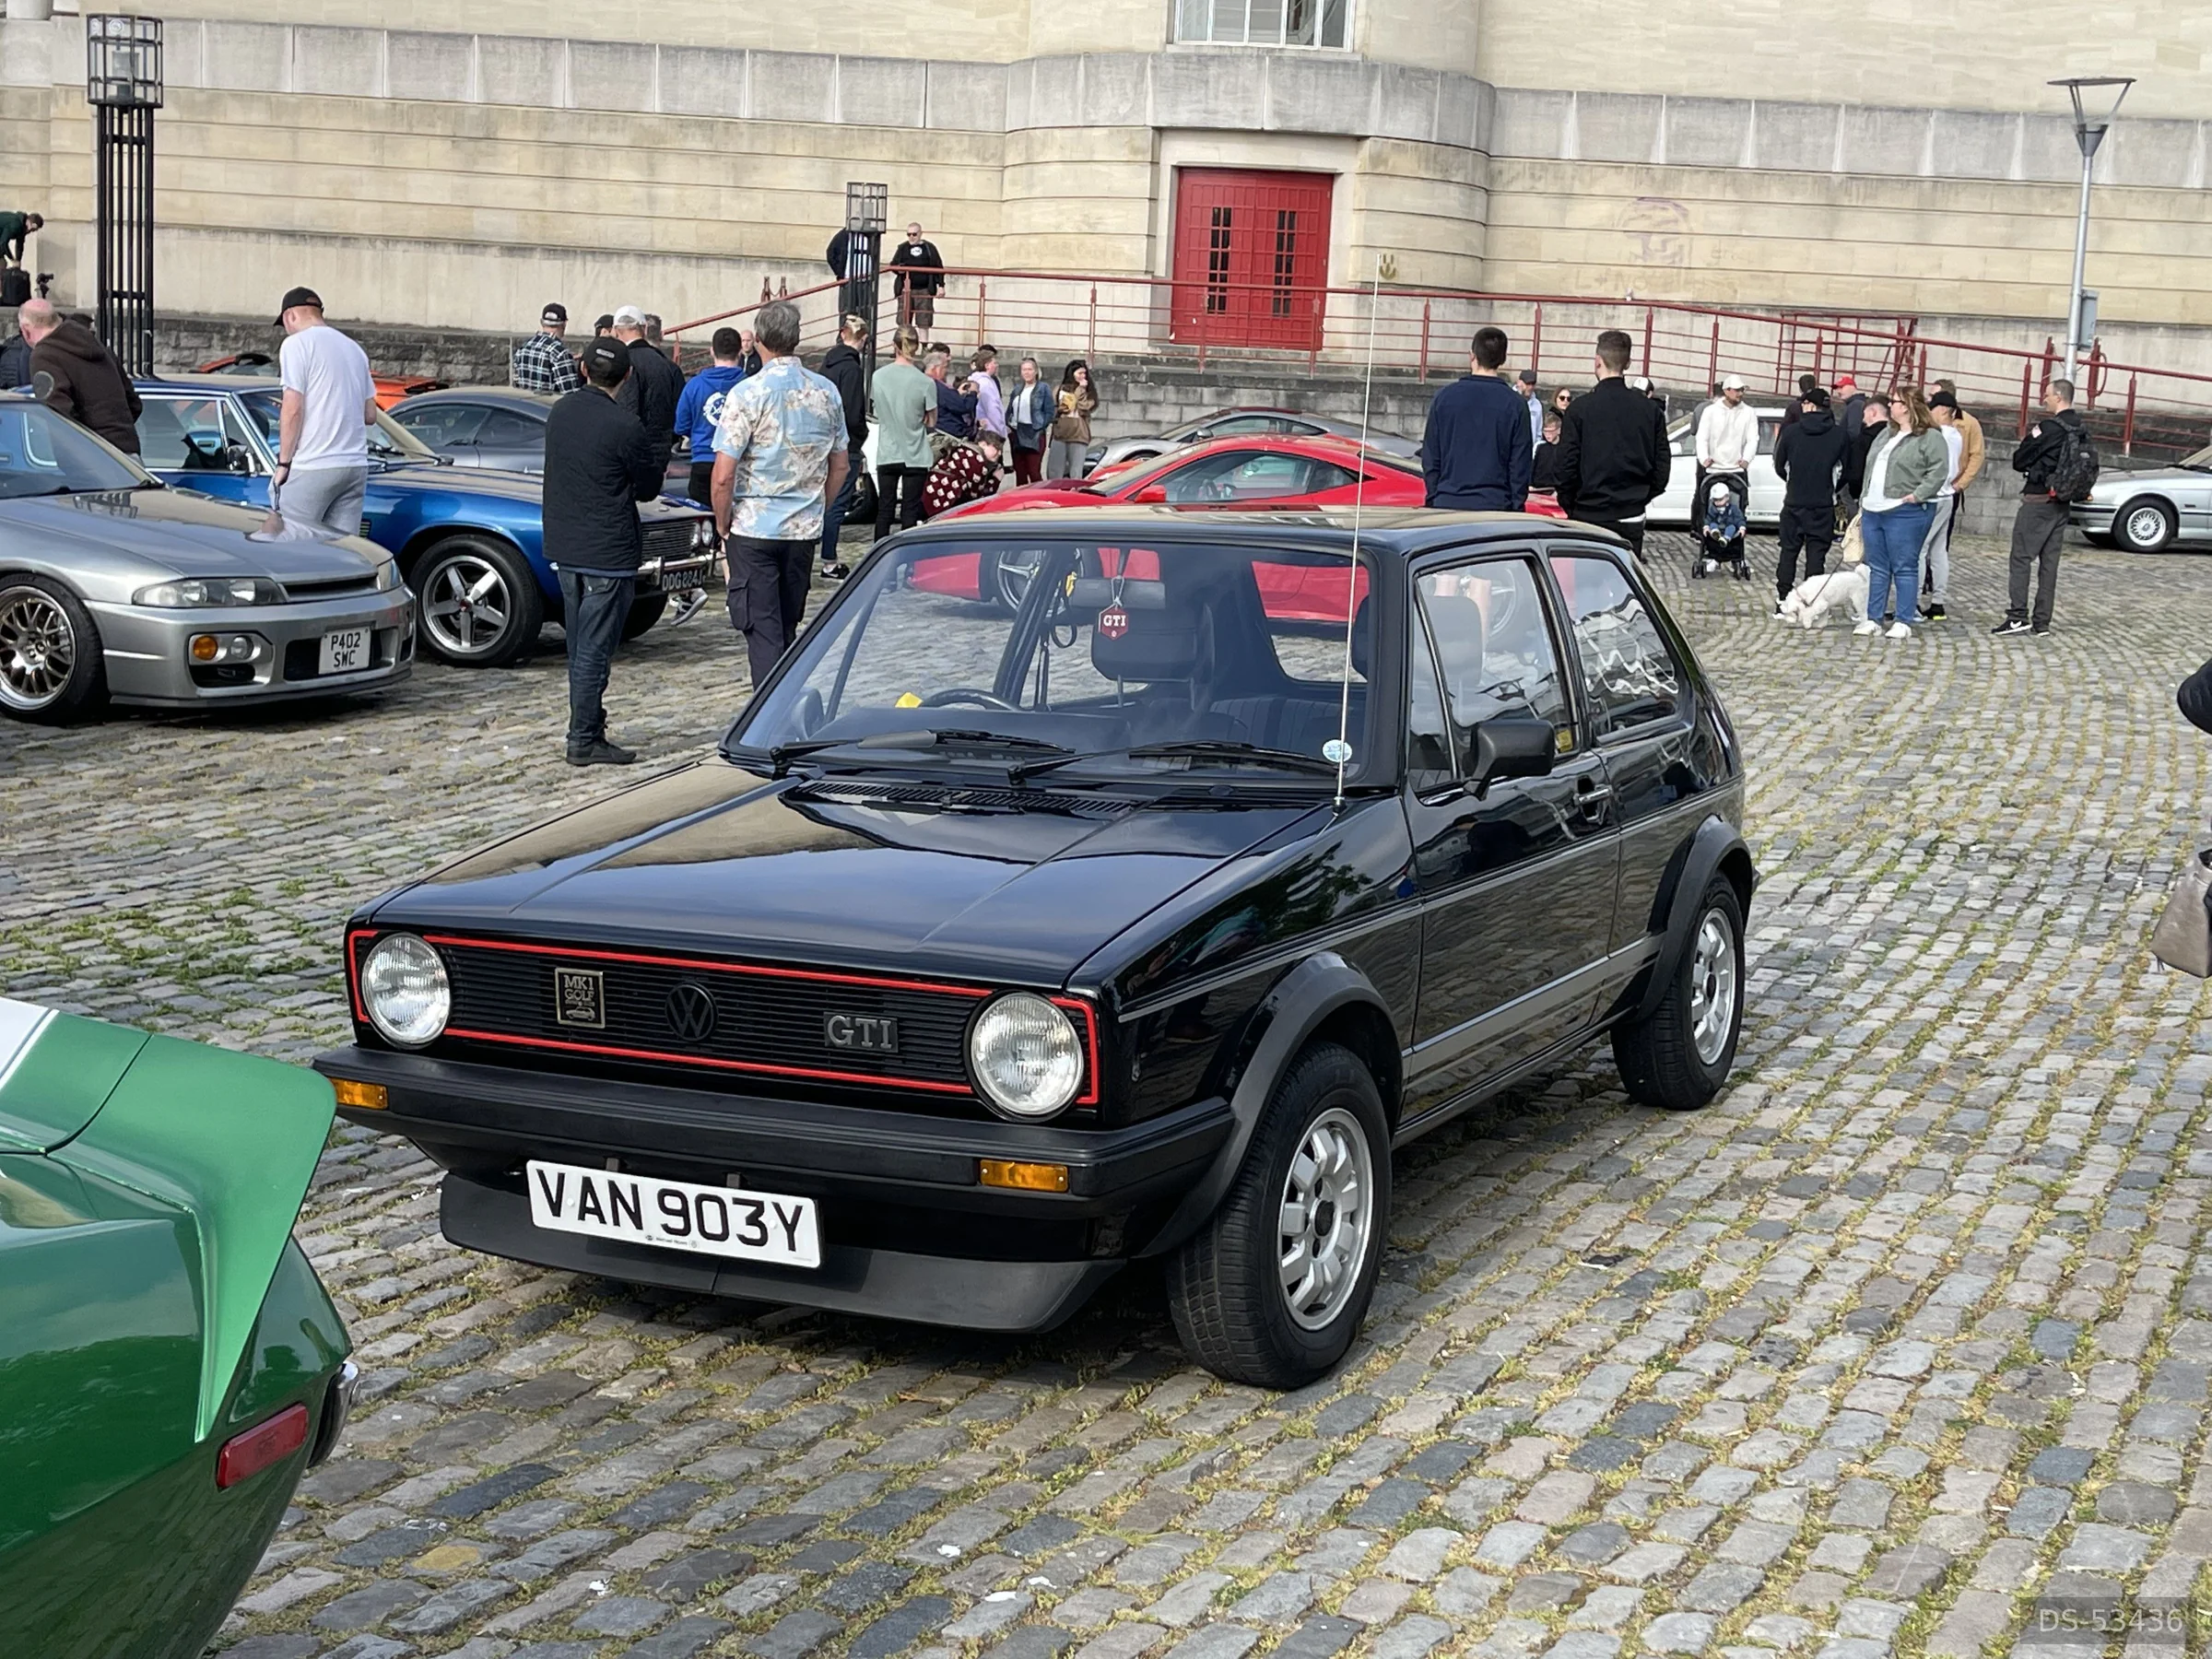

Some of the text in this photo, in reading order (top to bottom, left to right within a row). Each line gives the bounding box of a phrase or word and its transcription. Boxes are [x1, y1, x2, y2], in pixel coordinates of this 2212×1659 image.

[1103, 615, 1126, 627] GTI
[331, 631, 360, 651] P402
[563, 974, 594, 991] MK1
[564, 988, 595, 1001] GOLF
[828, 1015, 892, 1050] GTI
[535, 1168, 804, 1253] VAN 903Y
